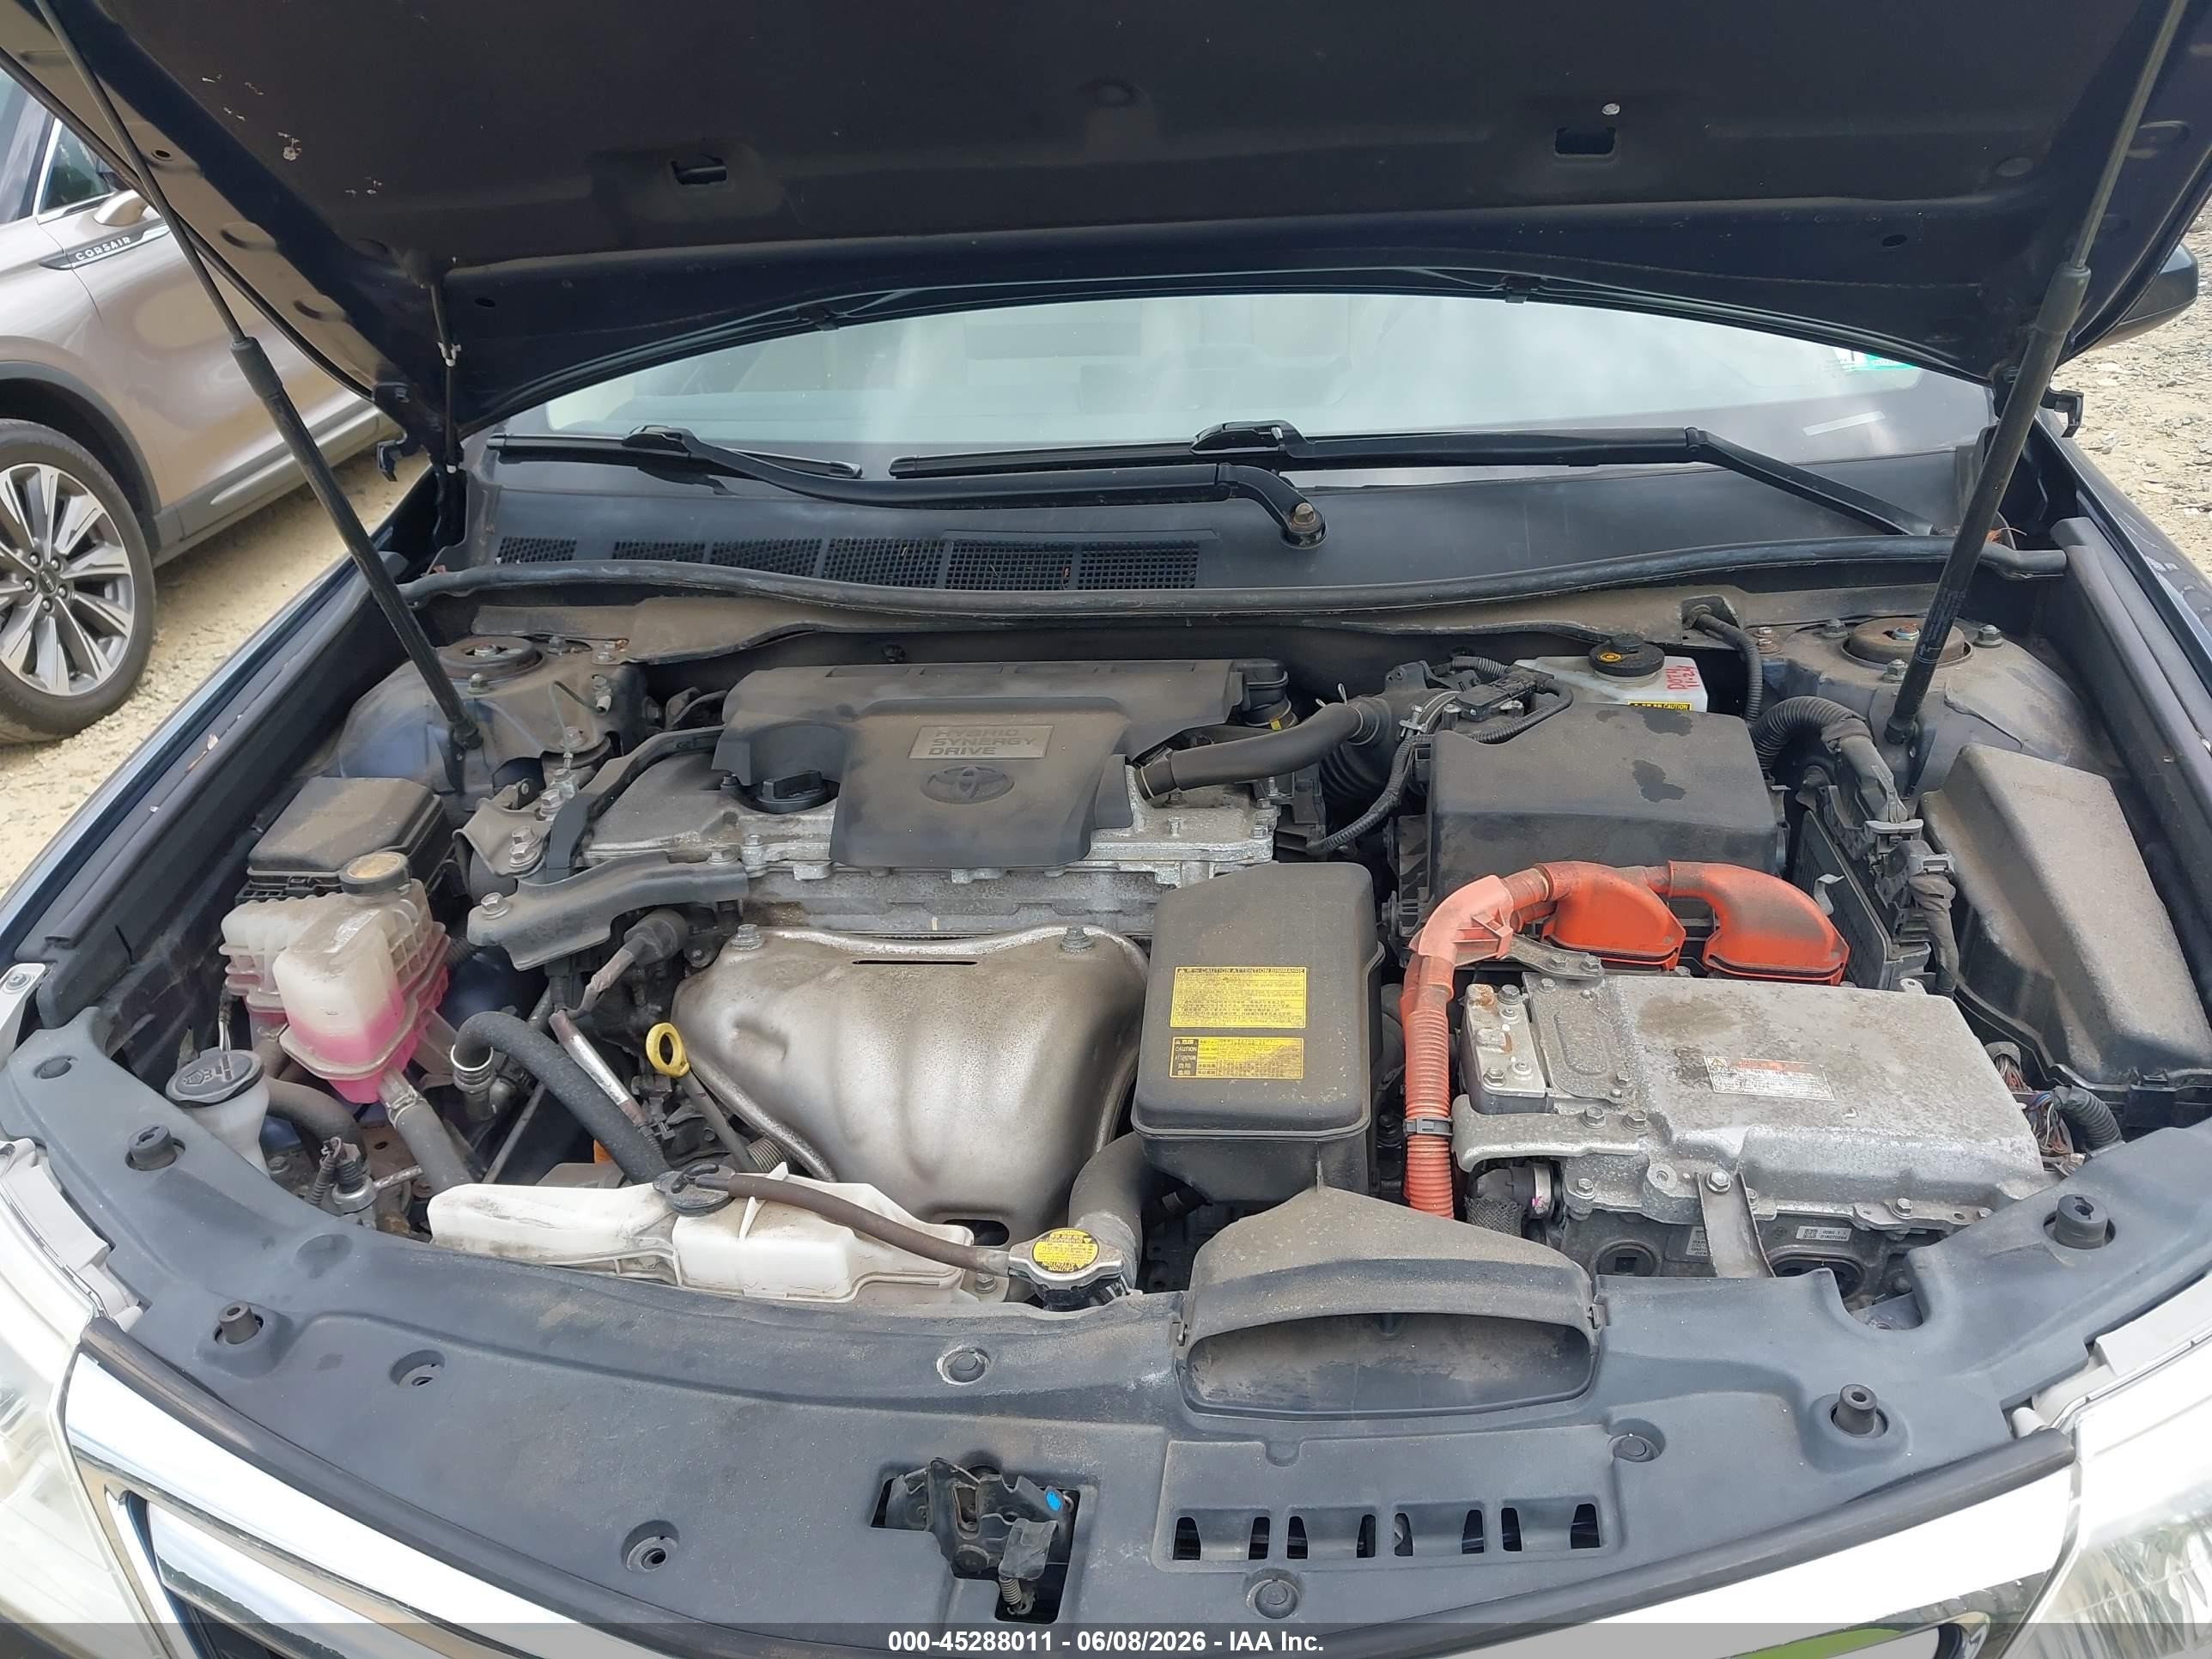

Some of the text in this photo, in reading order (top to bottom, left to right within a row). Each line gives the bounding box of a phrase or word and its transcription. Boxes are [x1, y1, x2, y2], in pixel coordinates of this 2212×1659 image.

[75, 236, 131, 261] CORSAIR
[934, 728, 1020, 738] HYBRID
[931, 738, 1037, 746] SYNERGY
[927, 746, 997, 756] DRIVE
